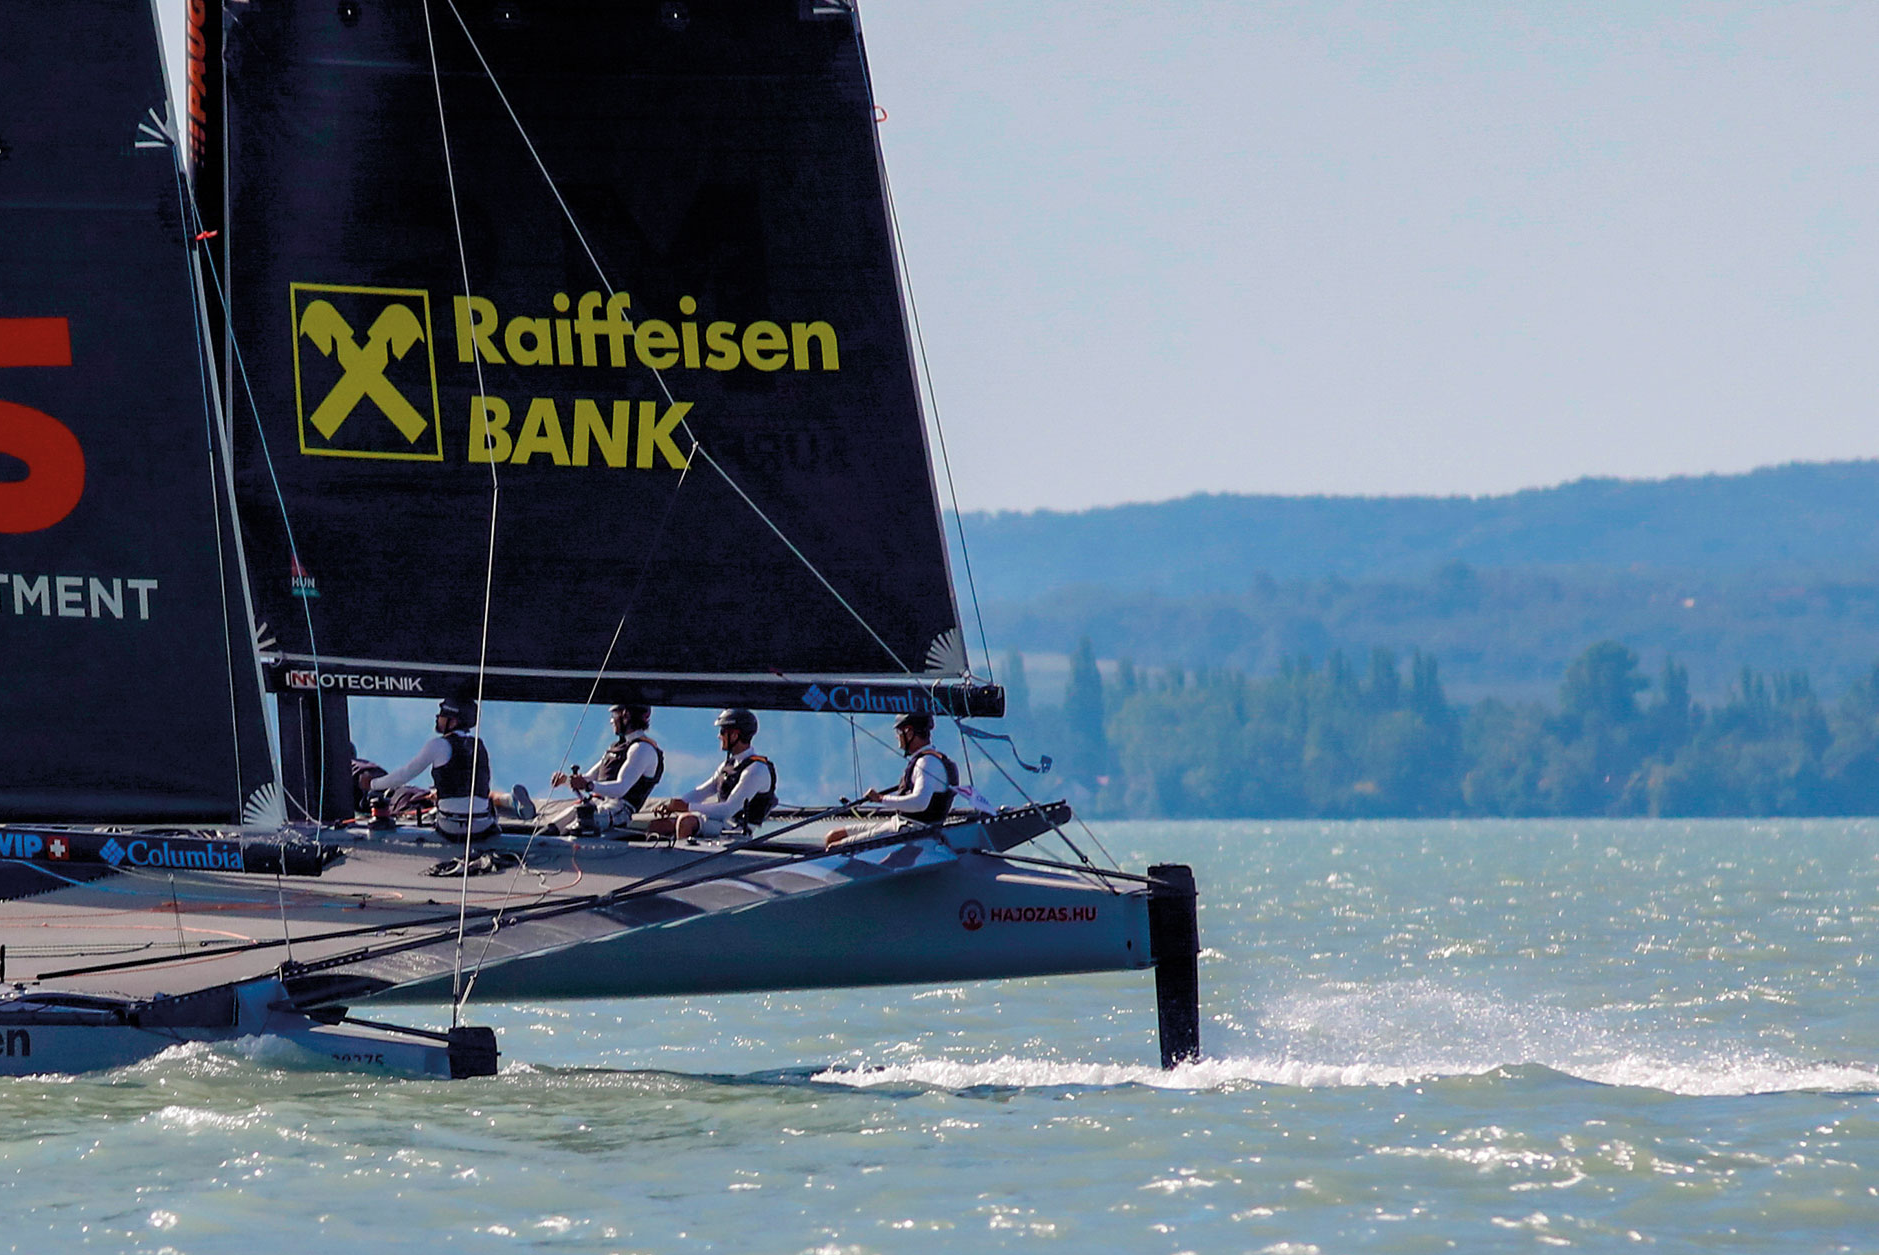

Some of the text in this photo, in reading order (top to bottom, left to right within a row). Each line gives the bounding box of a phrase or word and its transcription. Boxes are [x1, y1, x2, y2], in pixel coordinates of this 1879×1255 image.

[453, 291, 840, 371] Raiffeisen
[468, 396, 696, 470] BANK
[285, 670, 423, 691] INNOTECHNIK
[127, 839, 243, 869] Columbia
[990, 906, 1097, 922] HAJOZAS.HU
